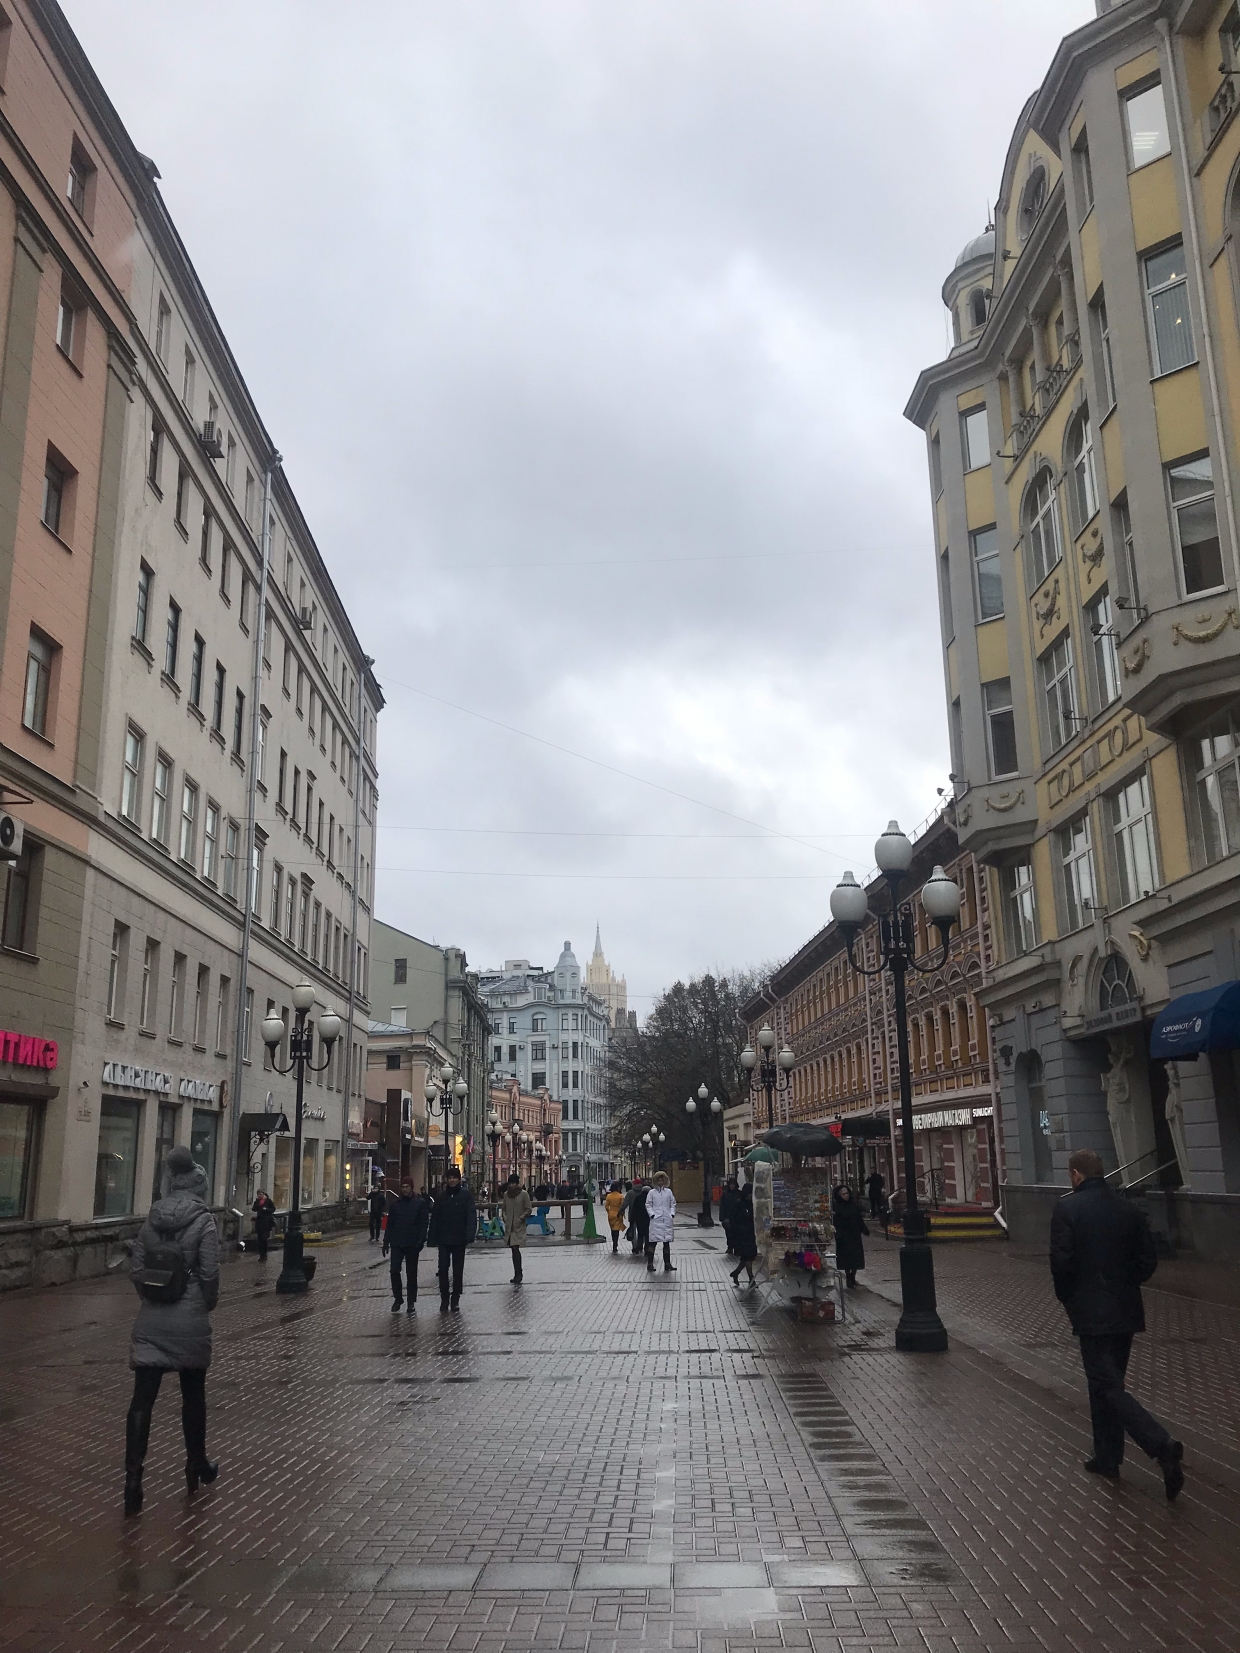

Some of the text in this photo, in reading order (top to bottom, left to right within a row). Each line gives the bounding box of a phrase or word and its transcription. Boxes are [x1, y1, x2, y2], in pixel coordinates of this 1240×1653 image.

[1161, 1022, 1189, 1033] АЭРОФЛОТ
[944, 1108, 972, 1126] МАГАЗИН
[973, 1106, 993, 1118] SUNLIGHT
